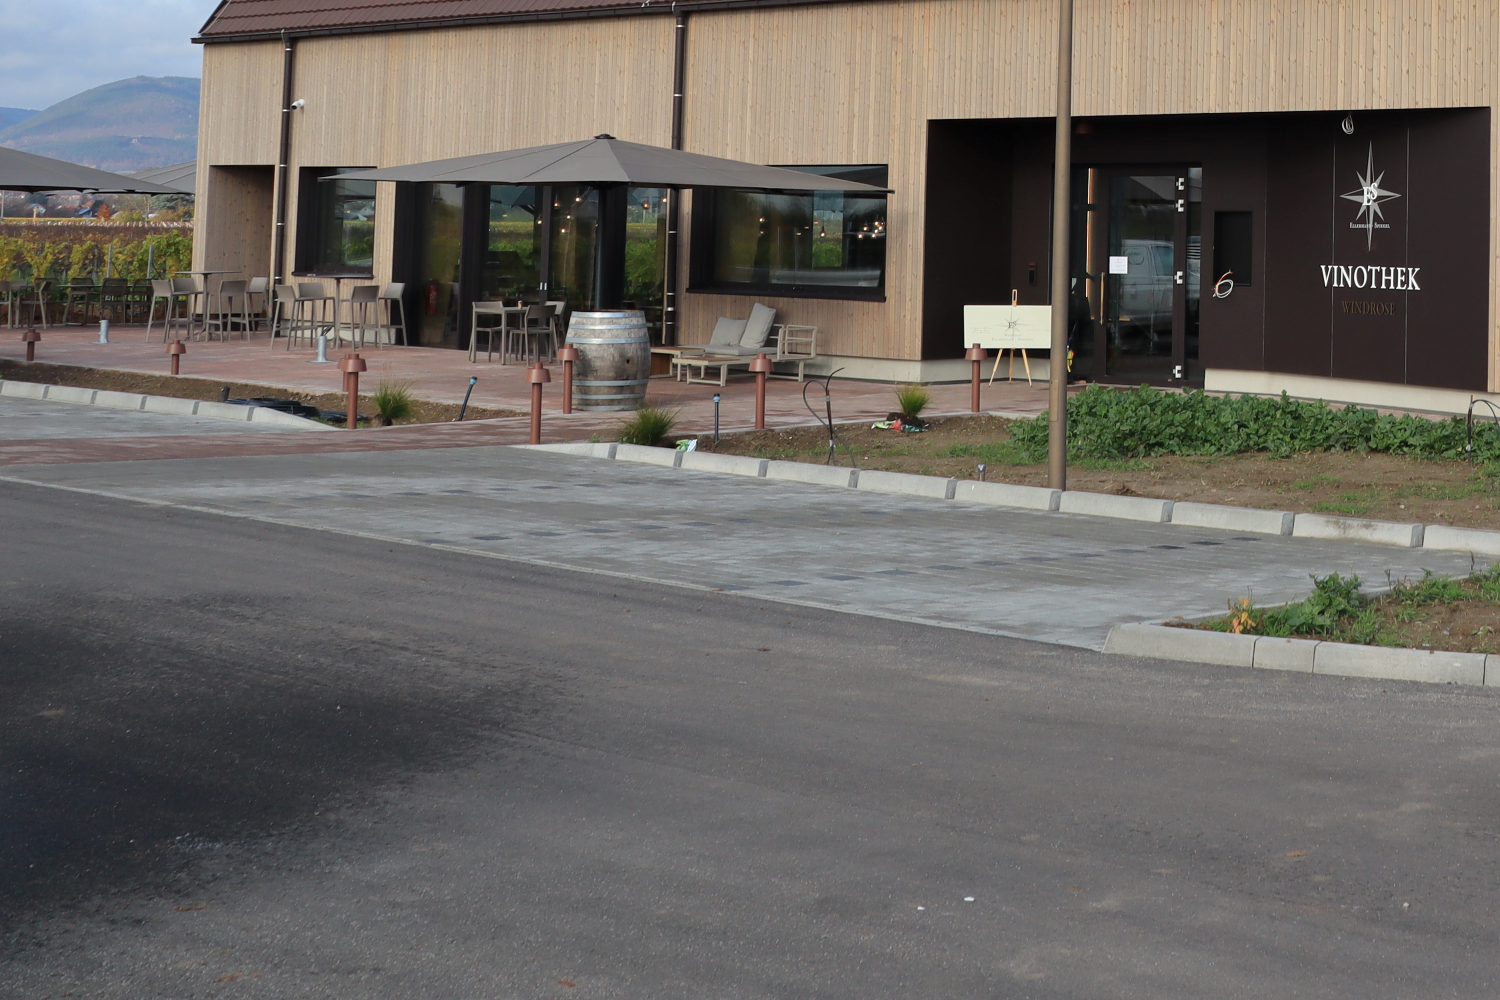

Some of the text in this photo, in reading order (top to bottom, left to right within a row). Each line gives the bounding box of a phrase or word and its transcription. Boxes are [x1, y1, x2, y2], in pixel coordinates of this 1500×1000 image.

[1362, 182, 1378, 206] ES
[1320, 265, 1421, 290] VINOTHEK
[1341, 300, 1397, 316] WINDROSE
